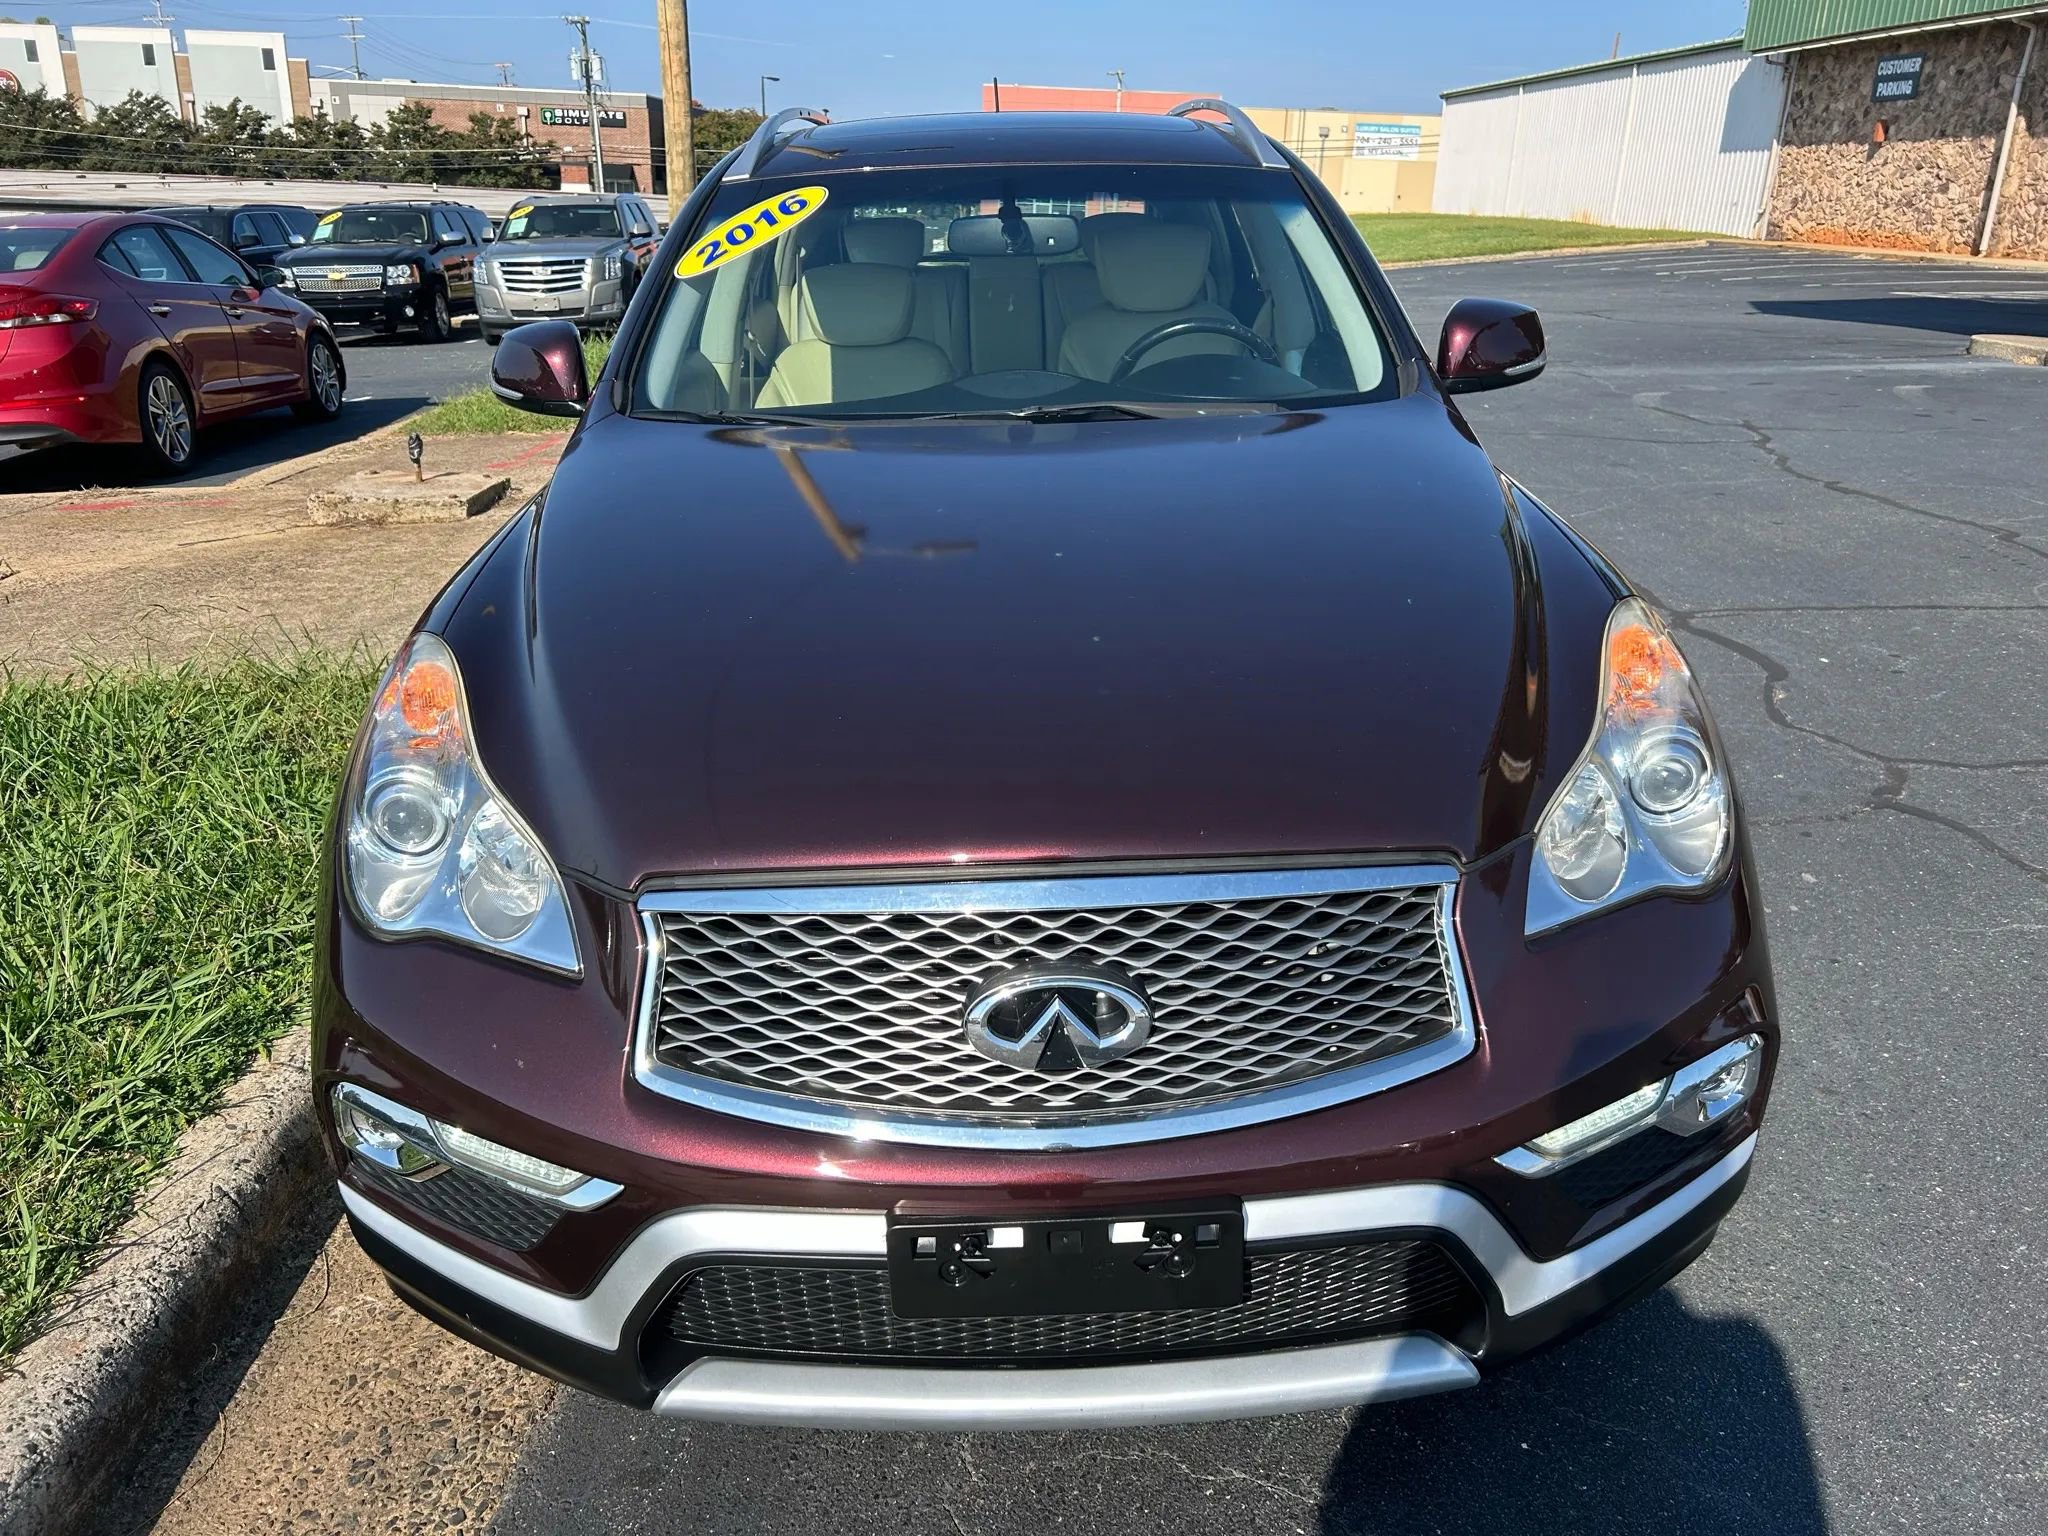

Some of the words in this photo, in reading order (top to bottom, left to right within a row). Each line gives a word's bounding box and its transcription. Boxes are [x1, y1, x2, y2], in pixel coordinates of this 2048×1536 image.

[1877, 57, 1922, 76] CUSTOMER
[1876, 79, 1913, 97] PARKING
[554, 109, 624, 120] SIMUATE
[555, 117, 589, 125] GOLF
[695, 193, 811, 269] 2016
